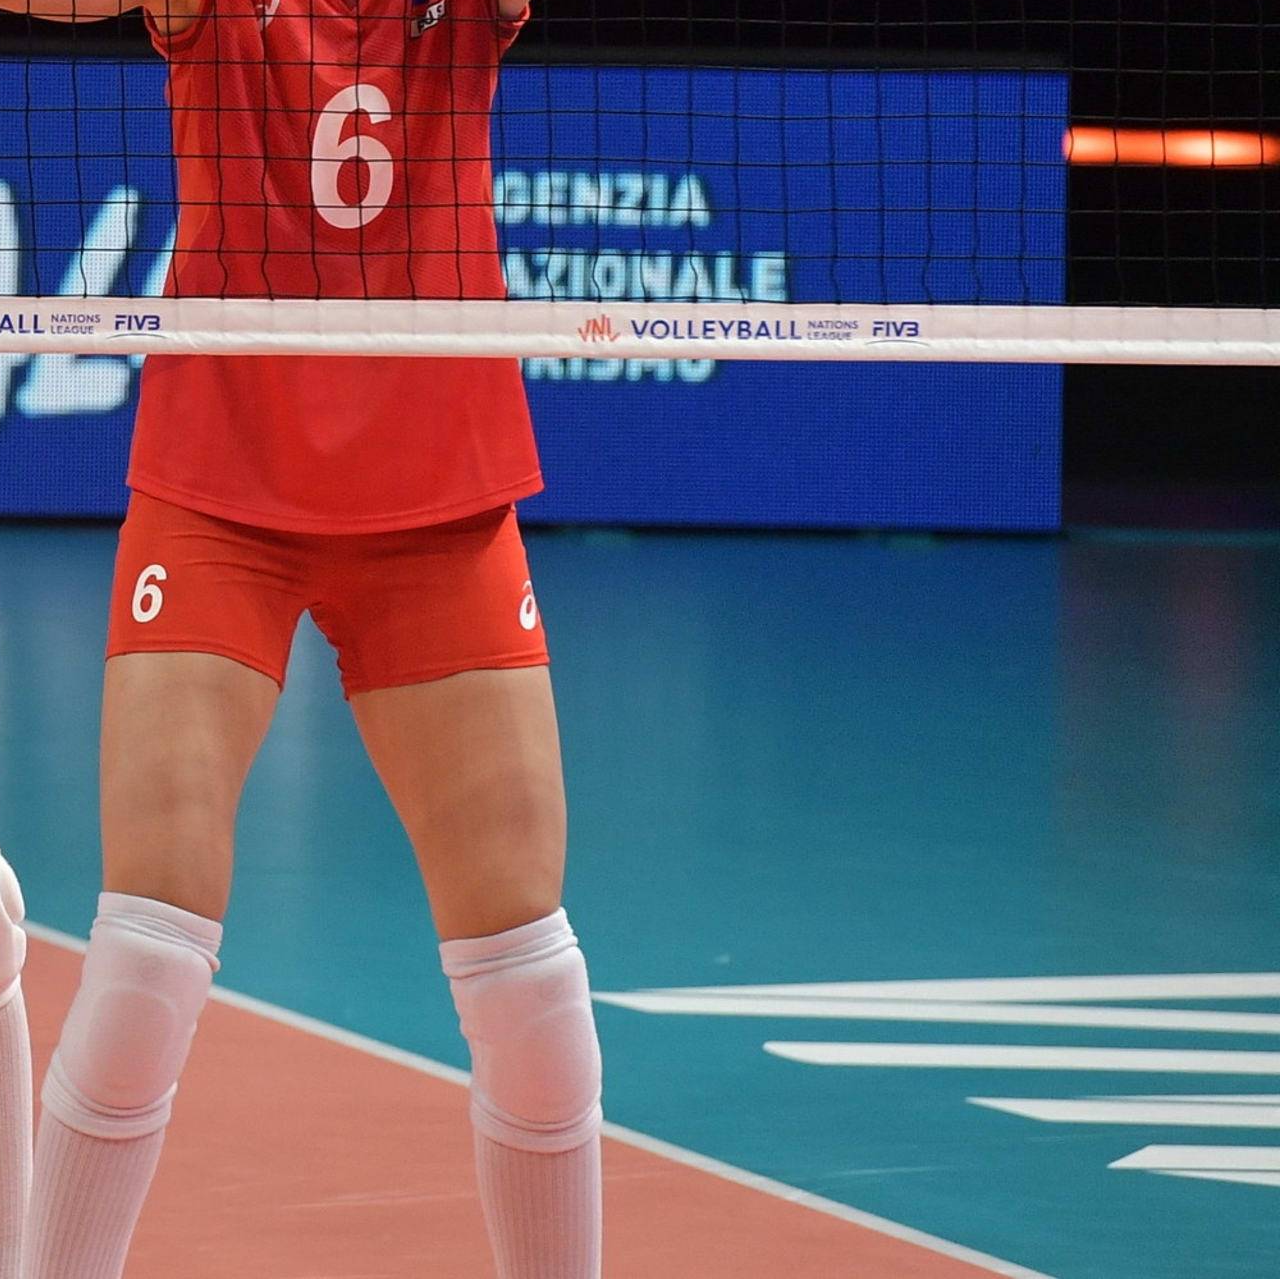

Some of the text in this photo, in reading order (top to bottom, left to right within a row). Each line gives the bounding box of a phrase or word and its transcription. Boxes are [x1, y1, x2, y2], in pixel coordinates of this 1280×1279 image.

[311, 84, 394, 229] 6
[50, 313, 102, 324] NATIONS
[114, 314, 161, 331] FIVB
[807, 320, 859, 330] NATIONS
[50, 325, 95, 335] LEAGUE
[630, 319, 802, 340] VOLLEYBALL
[872, 321, 919, 337] FIVB
[131, 564, 167, 623] 6
